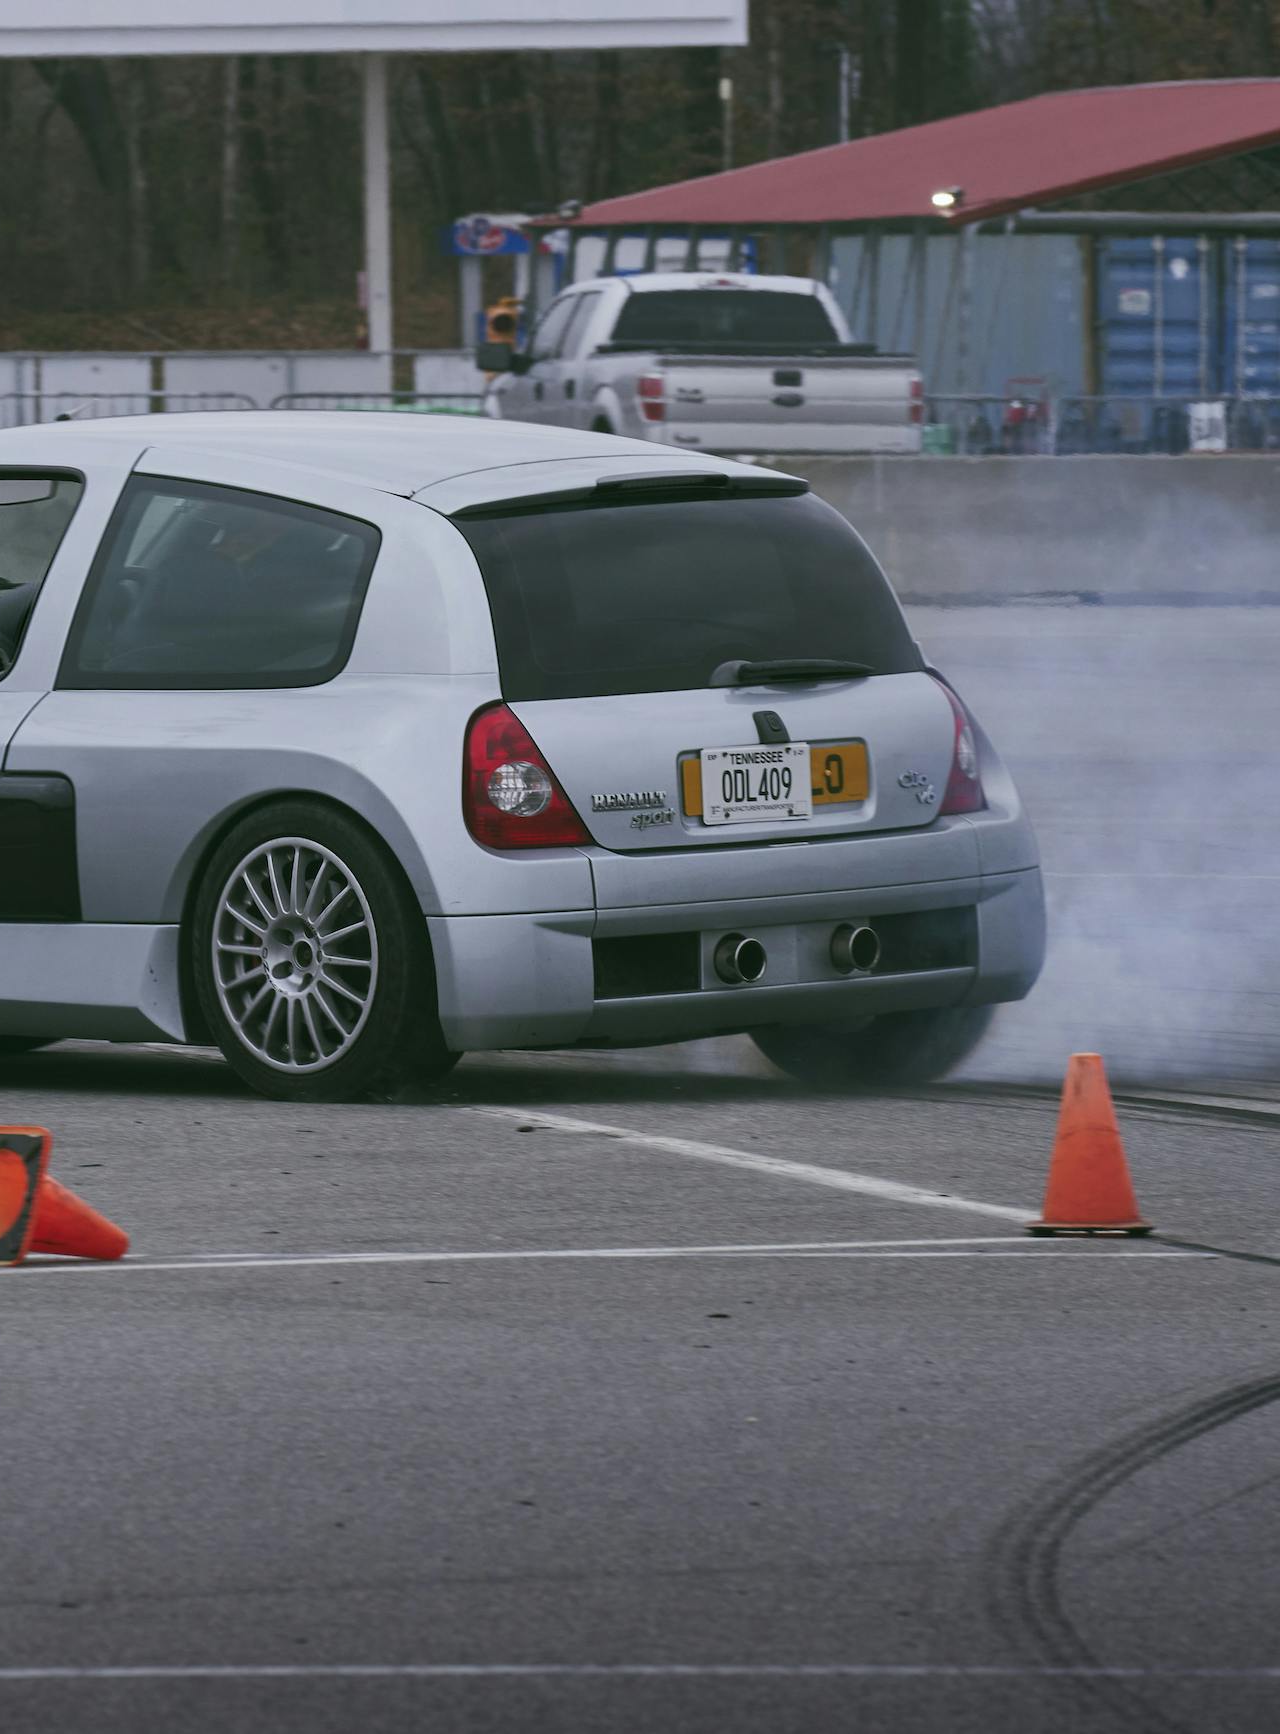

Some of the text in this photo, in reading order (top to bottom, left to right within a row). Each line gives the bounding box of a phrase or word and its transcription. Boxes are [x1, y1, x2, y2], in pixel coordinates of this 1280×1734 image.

[729, 751, 783, 765] TENNESSEE
[591, 791, 667, 811] RENAULT
[630, 807, 676, 832] sport
